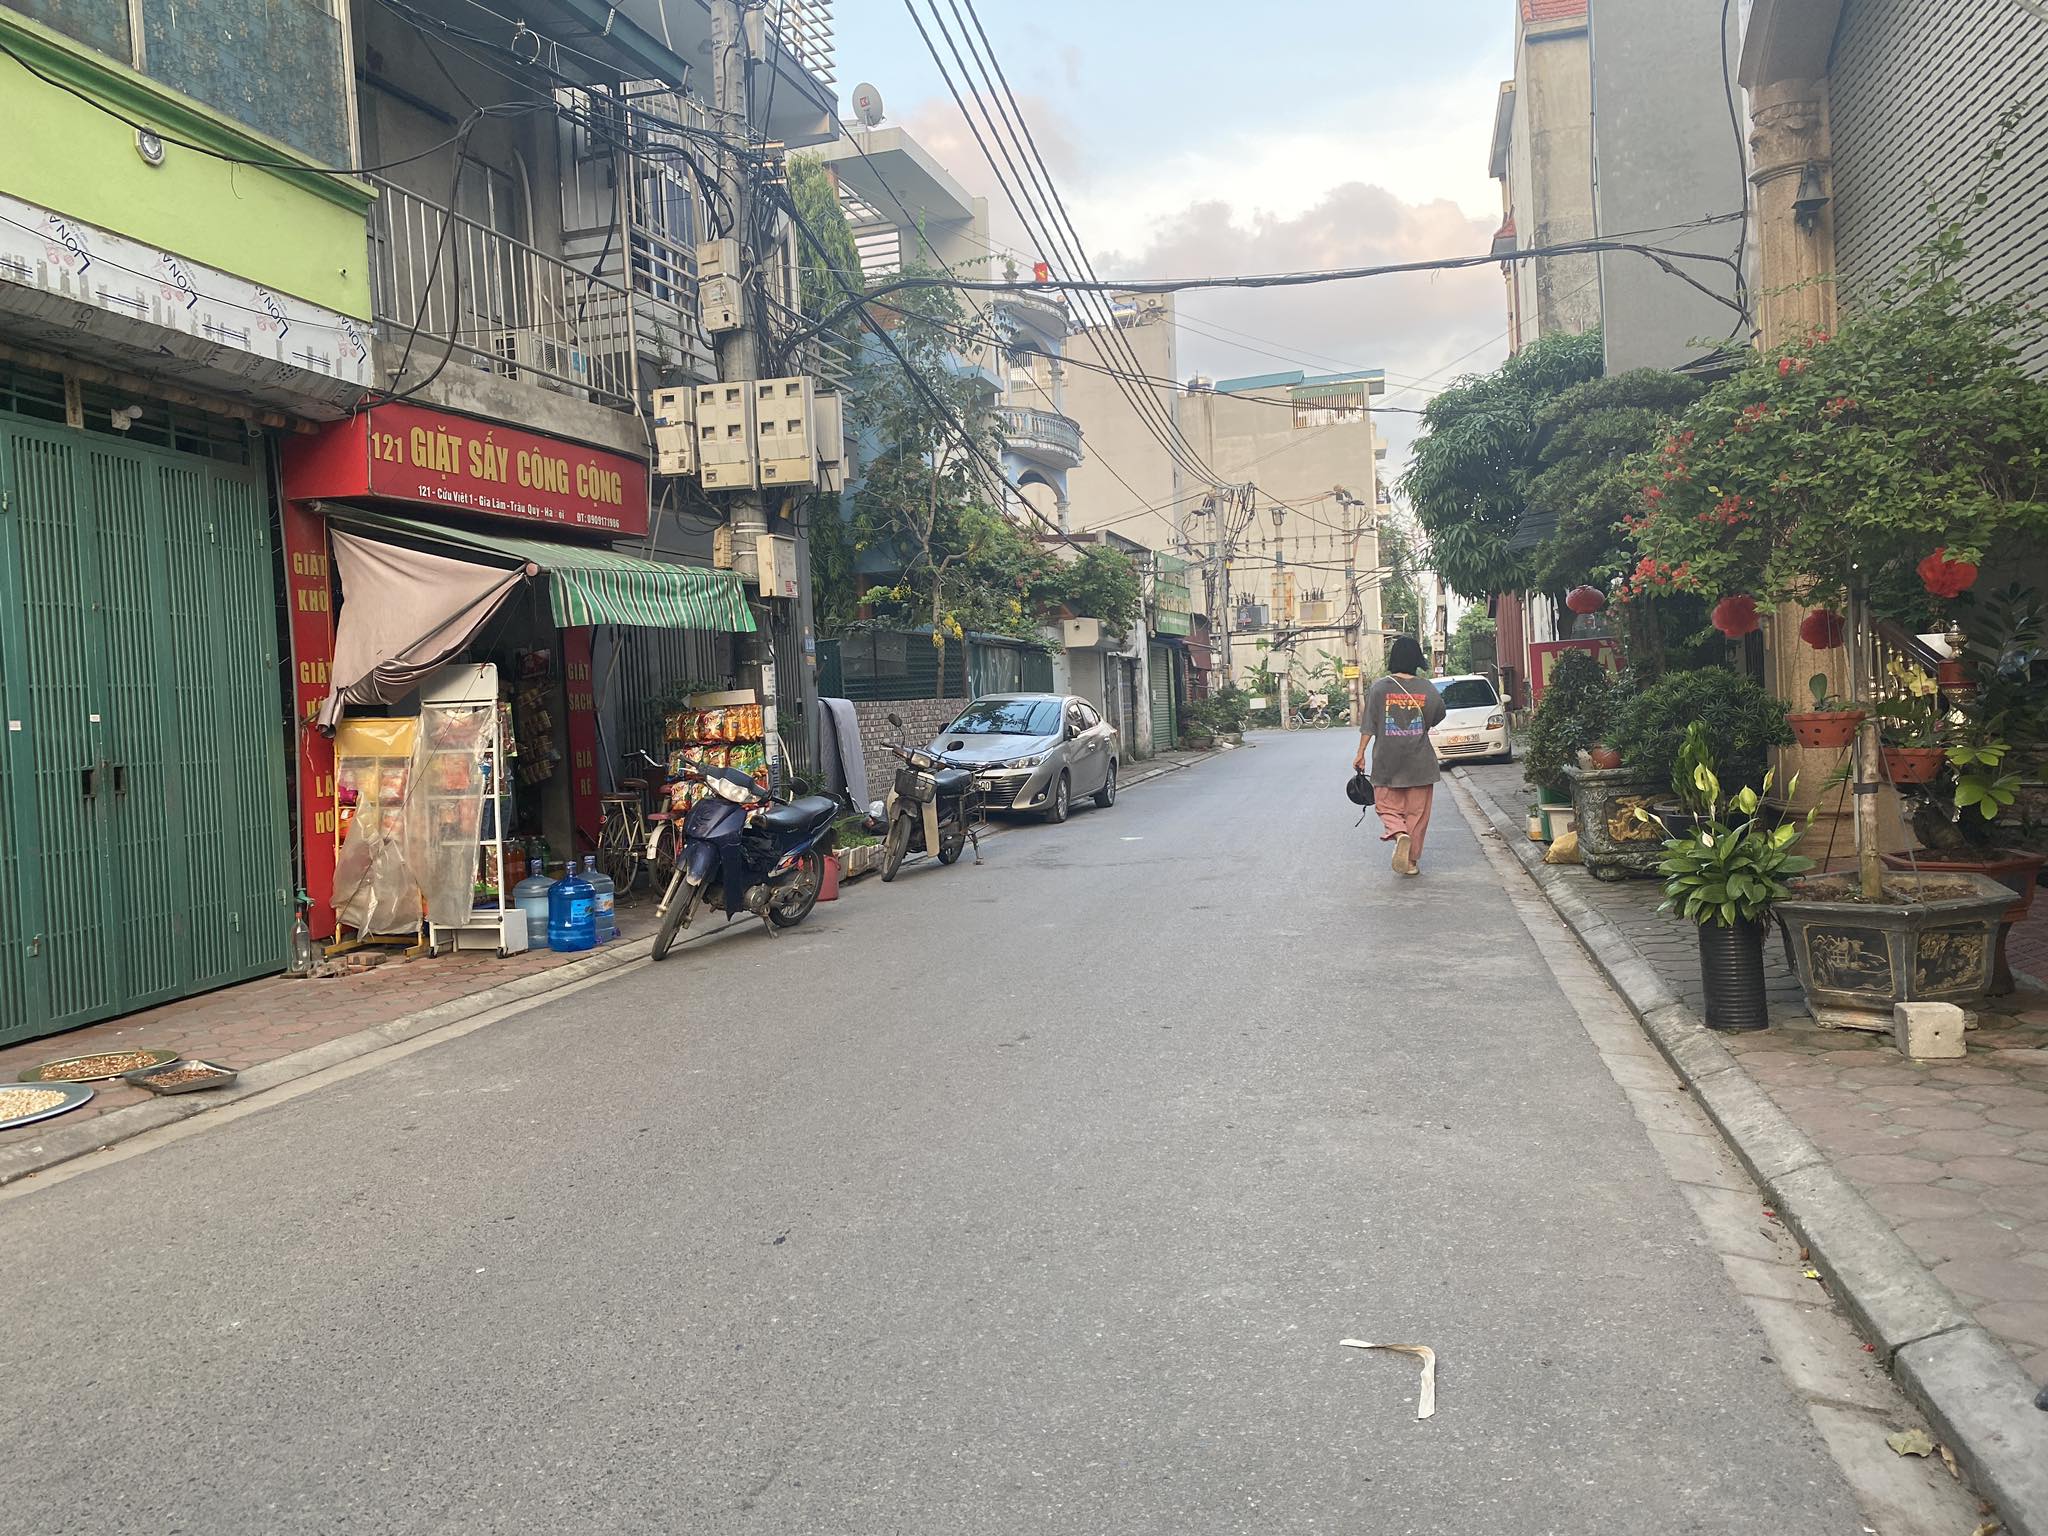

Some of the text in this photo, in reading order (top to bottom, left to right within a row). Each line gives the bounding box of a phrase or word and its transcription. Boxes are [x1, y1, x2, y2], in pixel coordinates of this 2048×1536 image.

[371, 424, 622, 508] 121 GIẶT SẤY CÔNG CỘNG
[418, 485, 431, 497] 121
